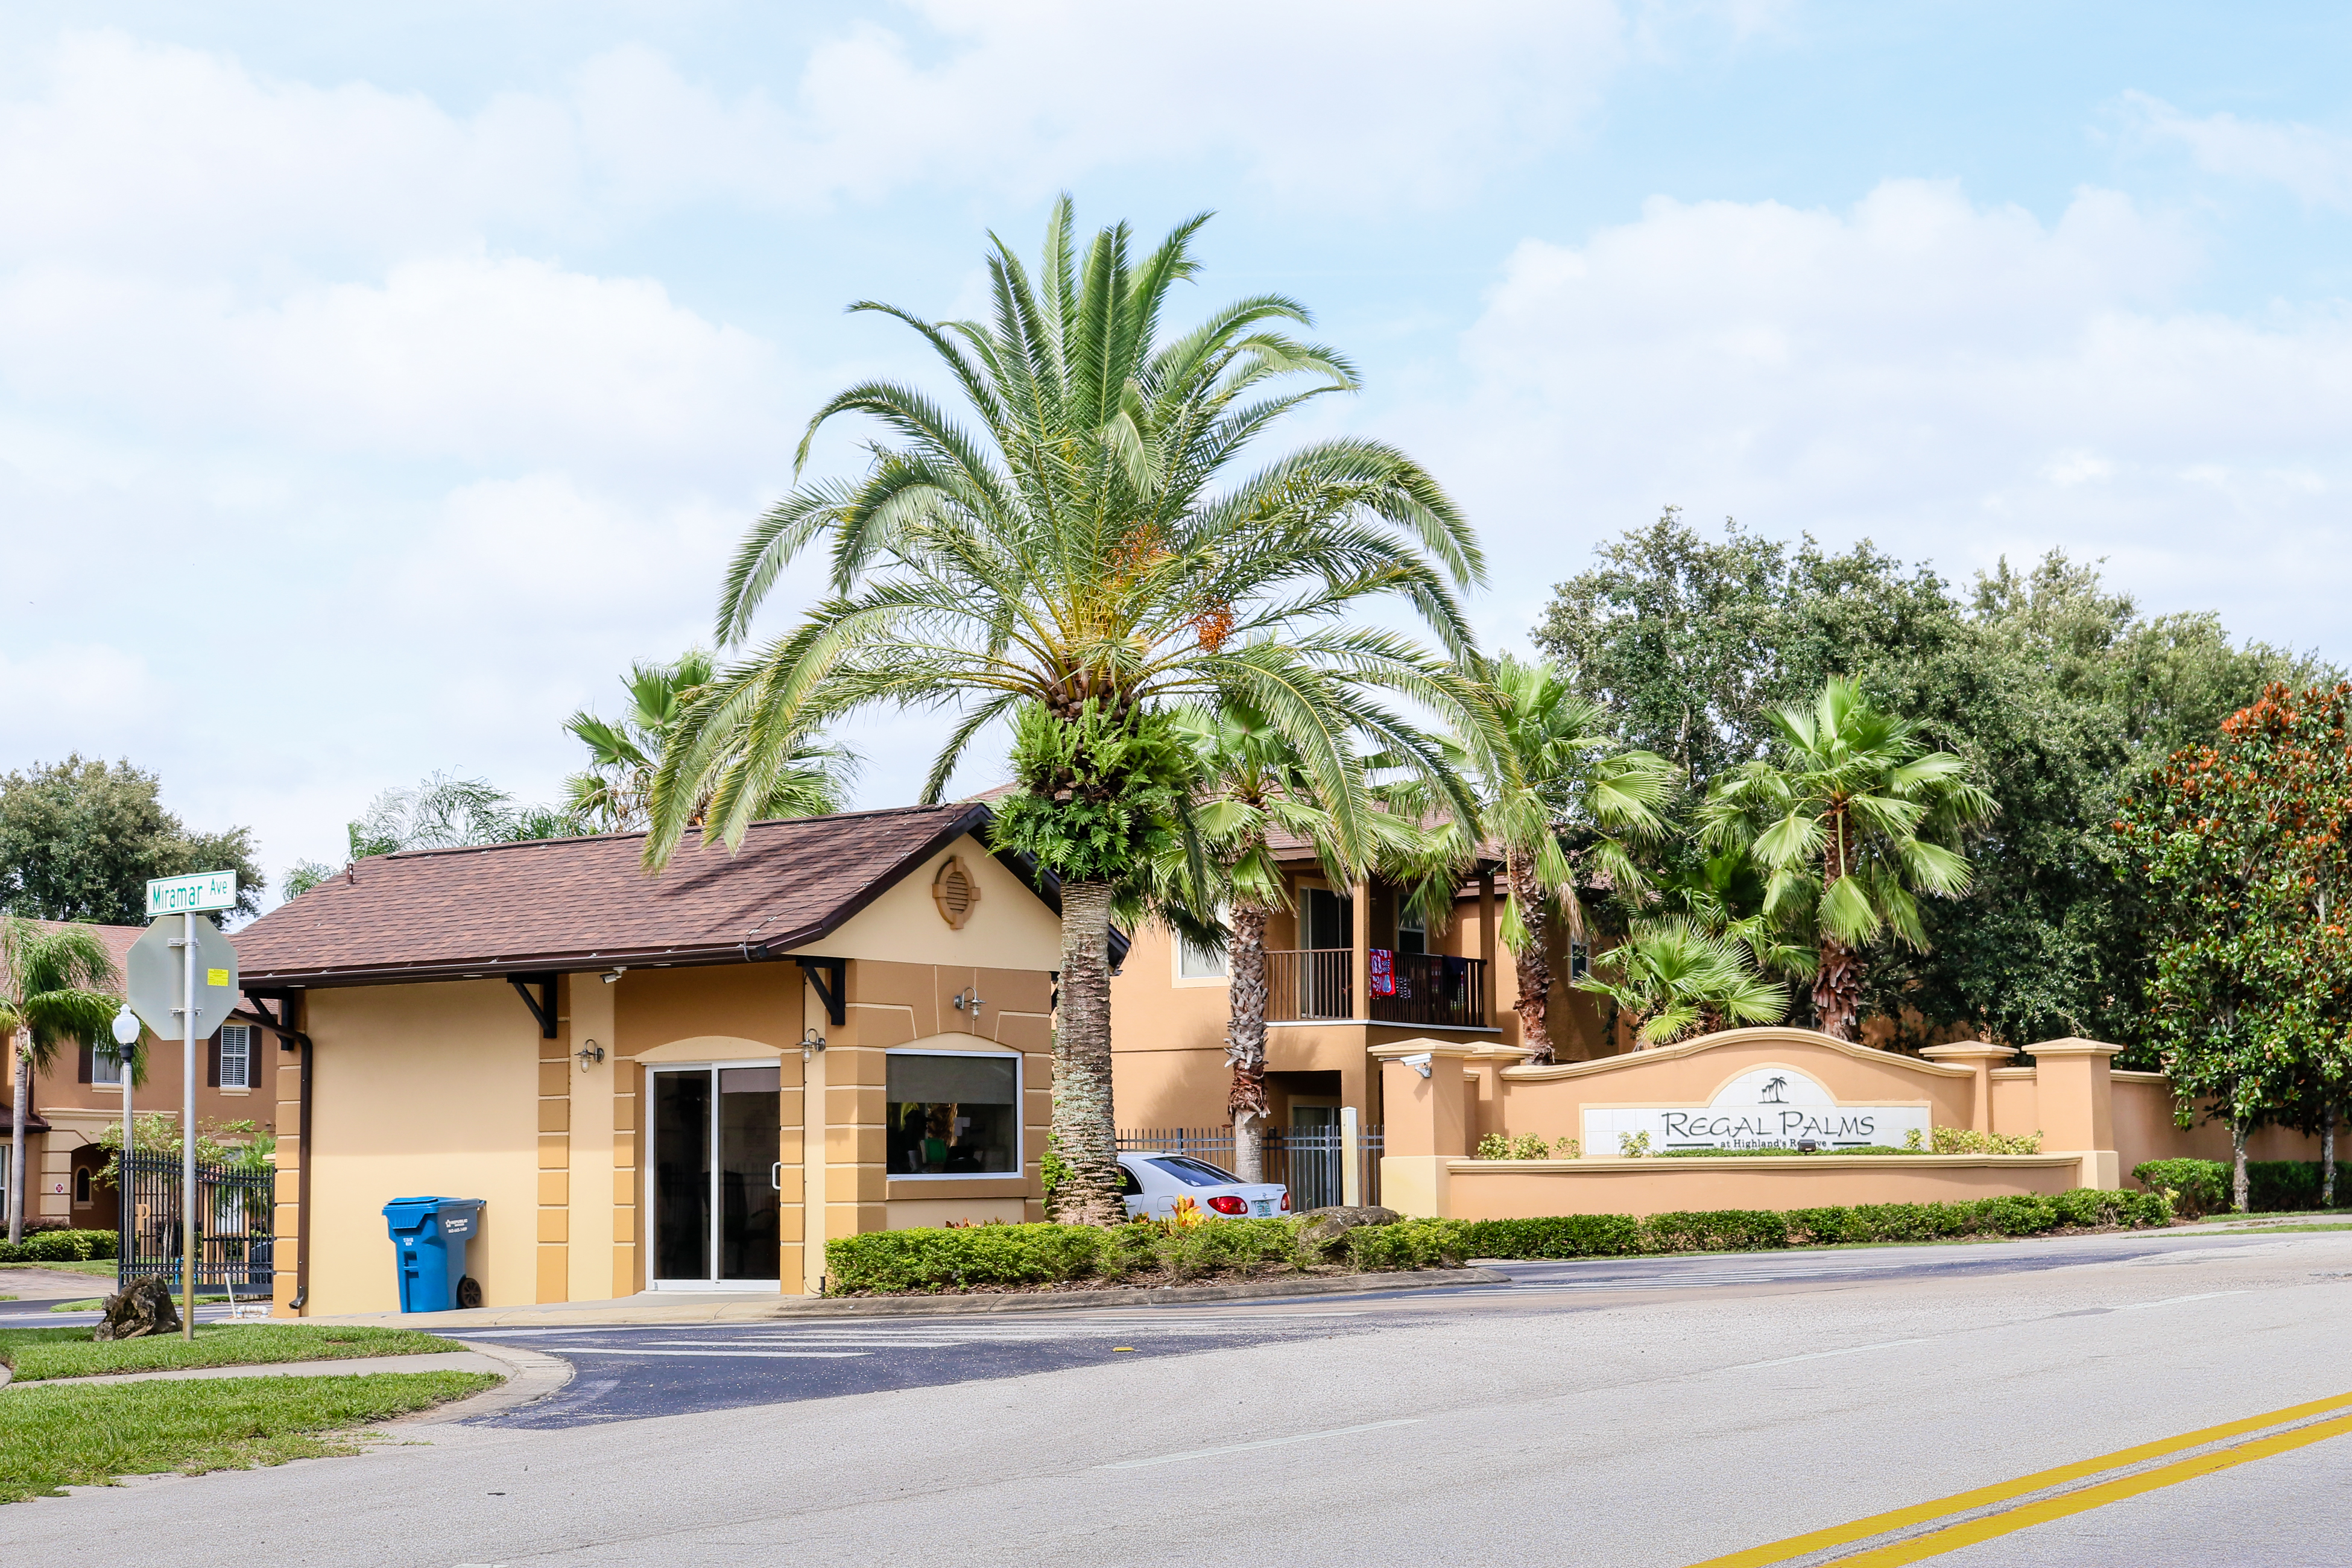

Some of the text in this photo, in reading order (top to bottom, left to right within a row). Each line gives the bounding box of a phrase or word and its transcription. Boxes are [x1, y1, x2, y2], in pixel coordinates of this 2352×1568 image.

[153, 878, 227, 911] Miramar Ave
[1661, 1110, 1875, 1137] REGAL PALMS
[1734, 1139, 1786, 1148] Highland's
